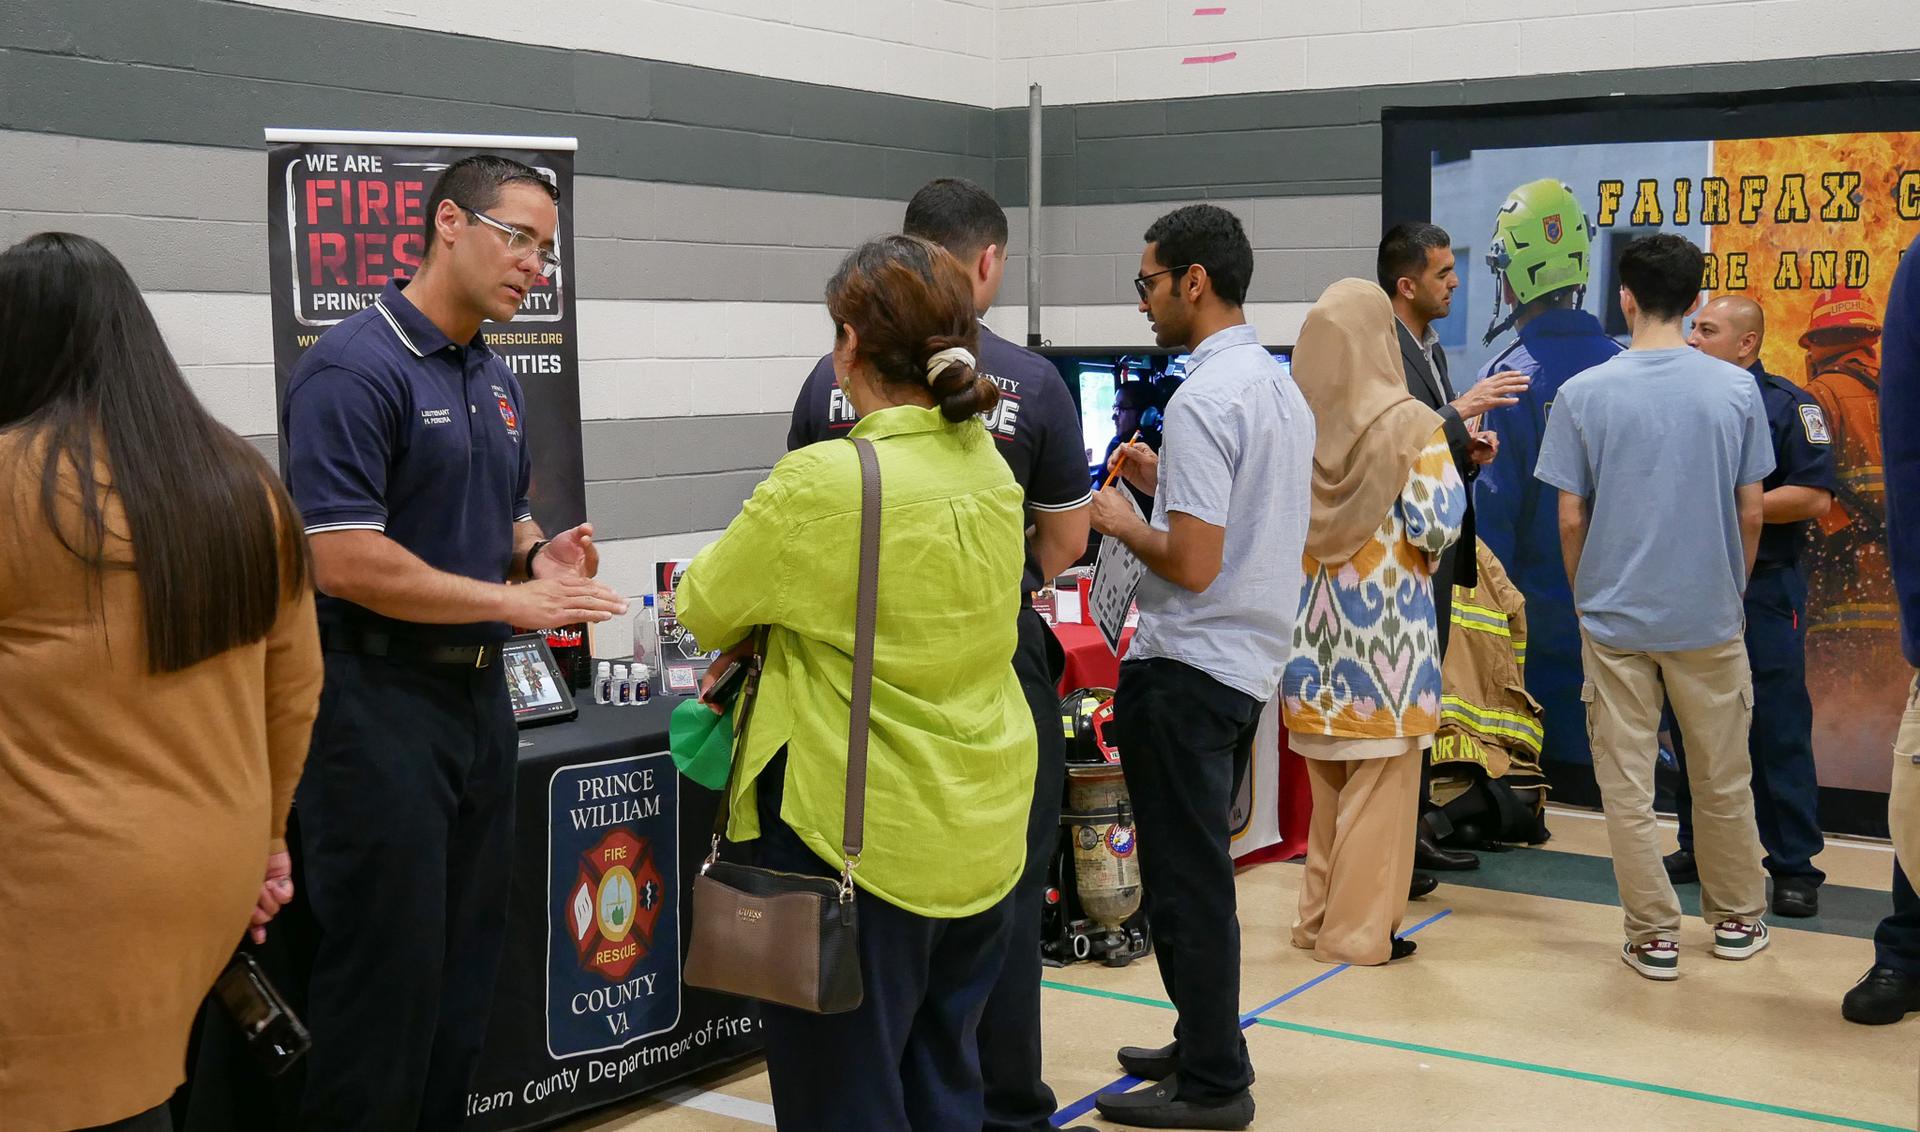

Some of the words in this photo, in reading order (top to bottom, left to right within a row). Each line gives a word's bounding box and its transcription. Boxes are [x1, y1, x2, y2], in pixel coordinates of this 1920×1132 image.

[305, 154, 338, 172] WE
[343, 154, 383, 173] ARE
[305, 179, 425, 226] FIRE
[1598, 171, 1861, 227] FAIRFAX
[1774, 250, 1870, 290] AND
[577, 769, 655, 801] PRINCE
[569, 794, 661, 831] WILLIAM
[604, 846, 627, 862] FIRE
[596, 942, 638, 965] RESCUE
[571, 972, 657, 1015] COUNTY
[606, 1011, 630, 1036] VA
[466, 1090, 514, 1117] liam
[523, 1067, 580, 1104] County
[588, 1032, 693, 1084] Department
[695, 1019, 713, 1046] of
[716, 1016, 752, 1040] Fire
